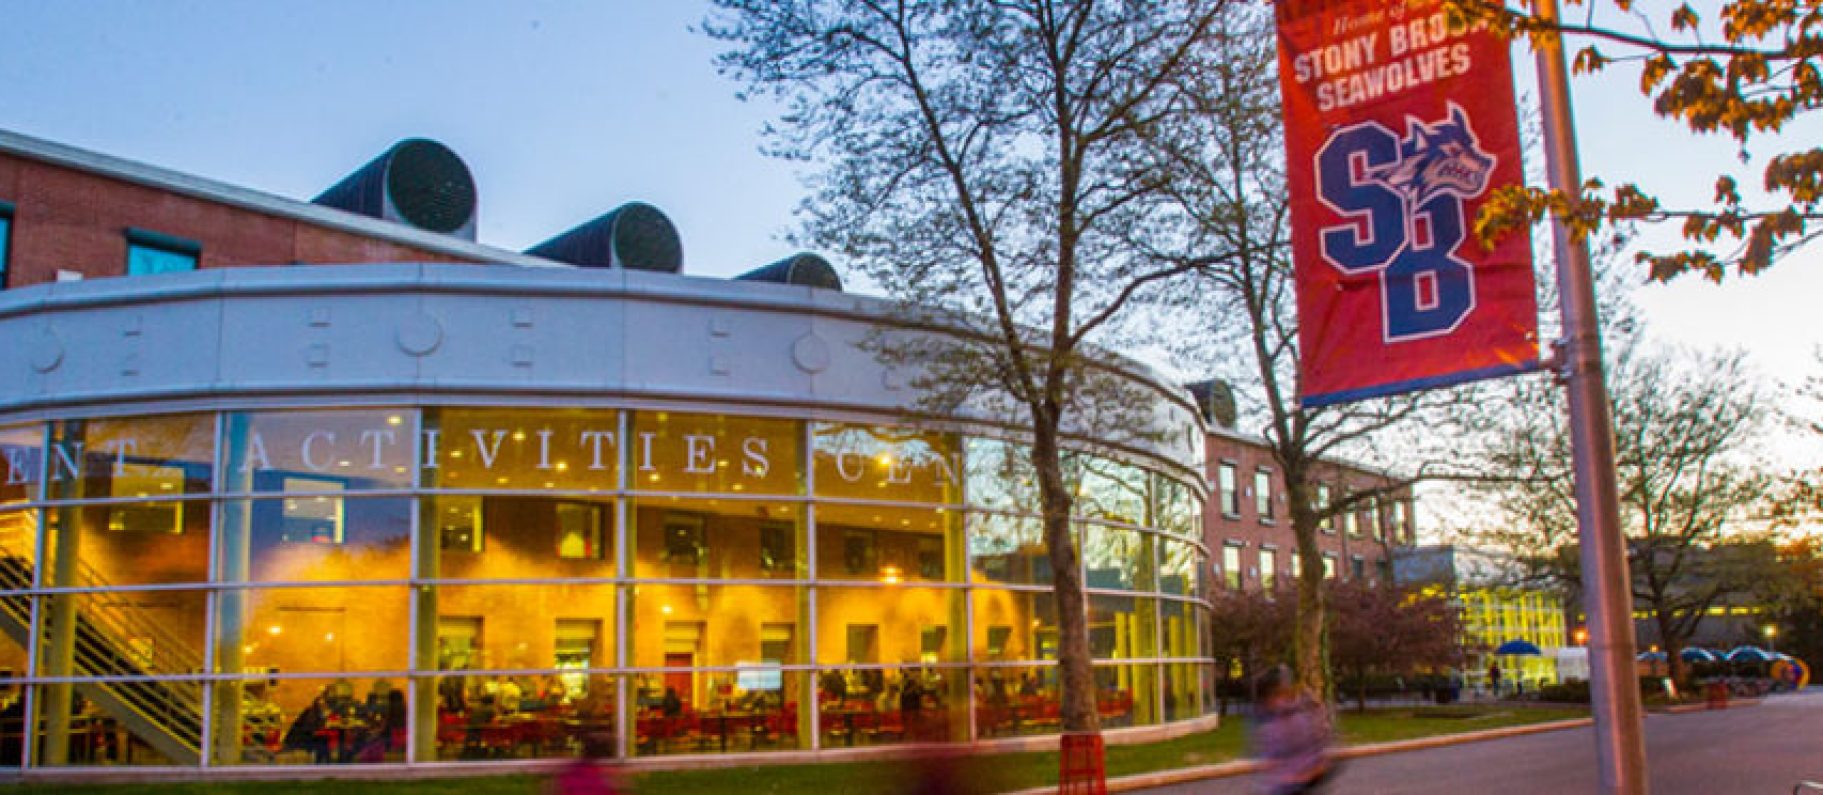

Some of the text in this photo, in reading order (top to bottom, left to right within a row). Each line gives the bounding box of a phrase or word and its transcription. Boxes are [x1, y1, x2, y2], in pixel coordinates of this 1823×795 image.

[1294, 3, 1489, 84] STONY BRO
[1316, 43, 1472, 111] SEAWOLVES
[239, 429, 770, 477] ACTIVITIES
